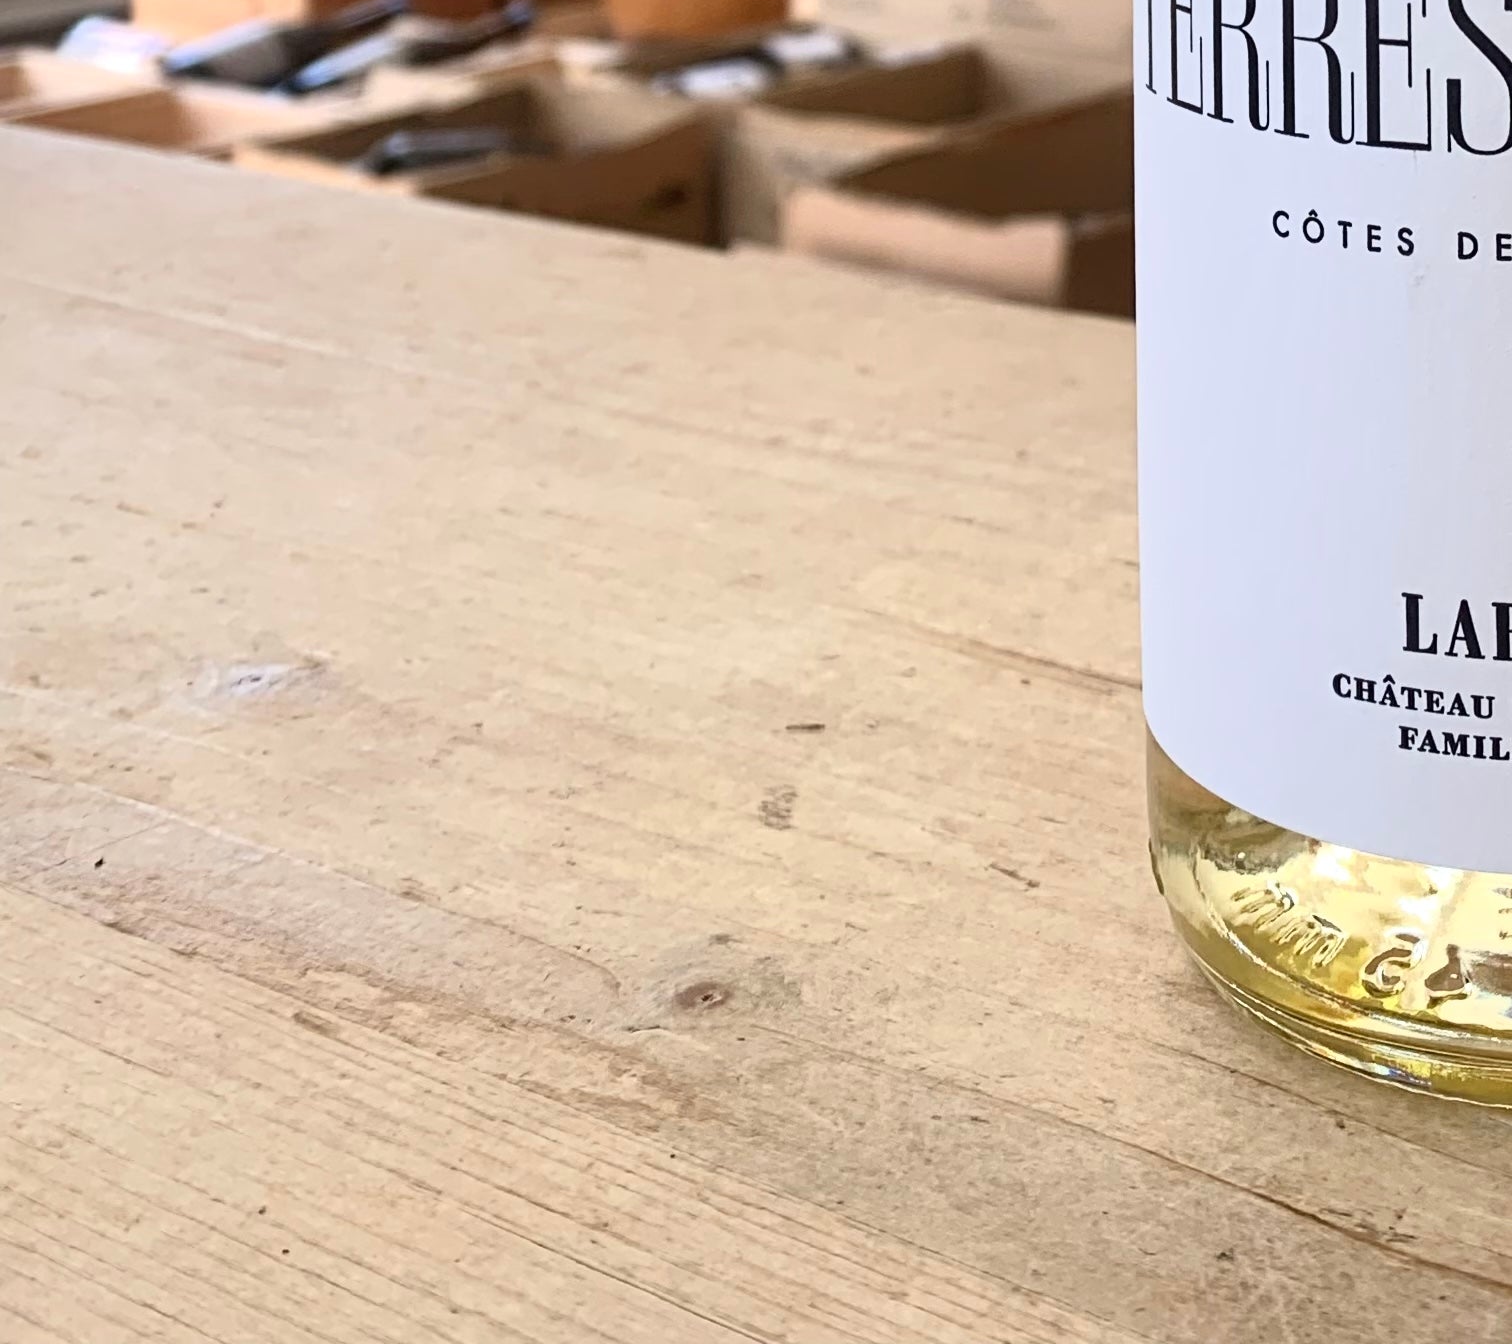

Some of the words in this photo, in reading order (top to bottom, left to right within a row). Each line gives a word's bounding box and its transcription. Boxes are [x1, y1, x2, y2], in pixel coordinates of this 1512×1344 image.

[1271, 208, 1415, 257] CÔTES
[1456, 230, 1512, 263] DE
[1331, 672, 1496, 720] CHÂTEAU
